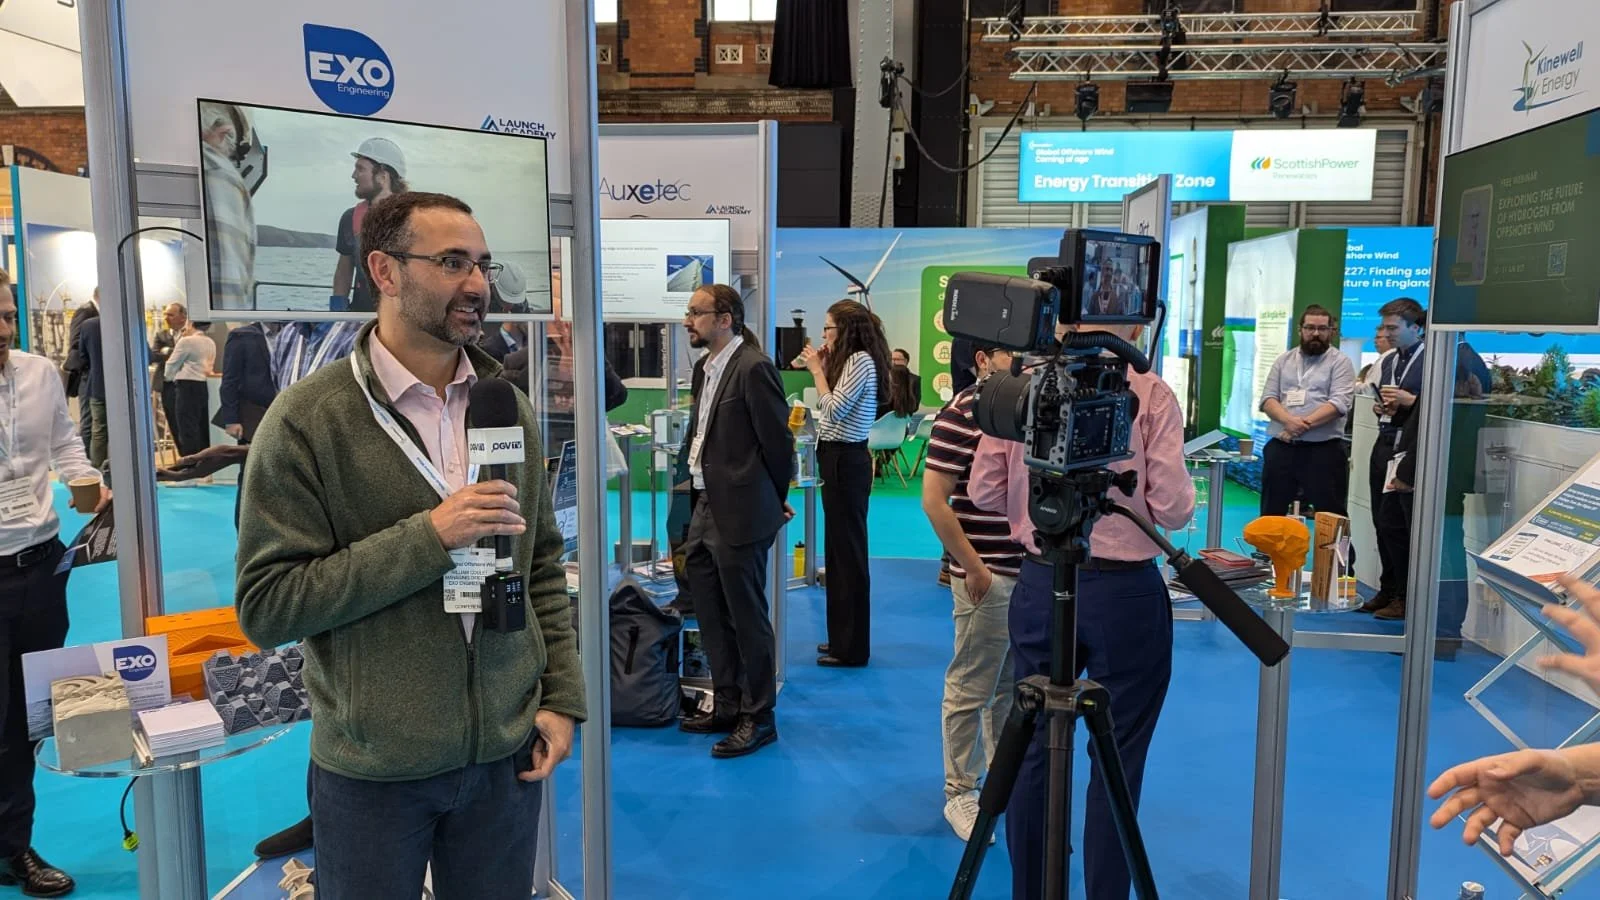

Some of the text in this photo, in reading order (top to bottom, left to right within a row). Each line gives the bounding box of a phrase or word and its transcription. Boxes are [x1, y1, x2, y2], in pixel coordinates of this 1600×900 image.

[1537, 40, 1583, 76] Kinewell
[309, 50, 391, 88] EXO
[1541, 67, 1580, 96] Energy
[337, 83, 390, 99] Engineering
[499, 118, 545, 131] LAUNCH
[1273, 158, 1360, 169] ScottishPower
[599, 177, 692, 203] Auxetec
[1034, 175, 1087, 191] Energy
[1175, 173, 1216, 188] Zone
[1499, 182, 1584, 210] EXPLORING THE FUTURE
[1497, 200, 1575, 224] OF HYDROGEN FROM
[1496, 219, 1555, 239] OFFSHORE WIND
[1346, 244, 1364, 252] bal
[1374, 252, 1400, 260] Wind
[1369, 267, 1412, 278] Finding
[1372, 278, 1383, 288] in
[115, 654, 155, 671] EXO
